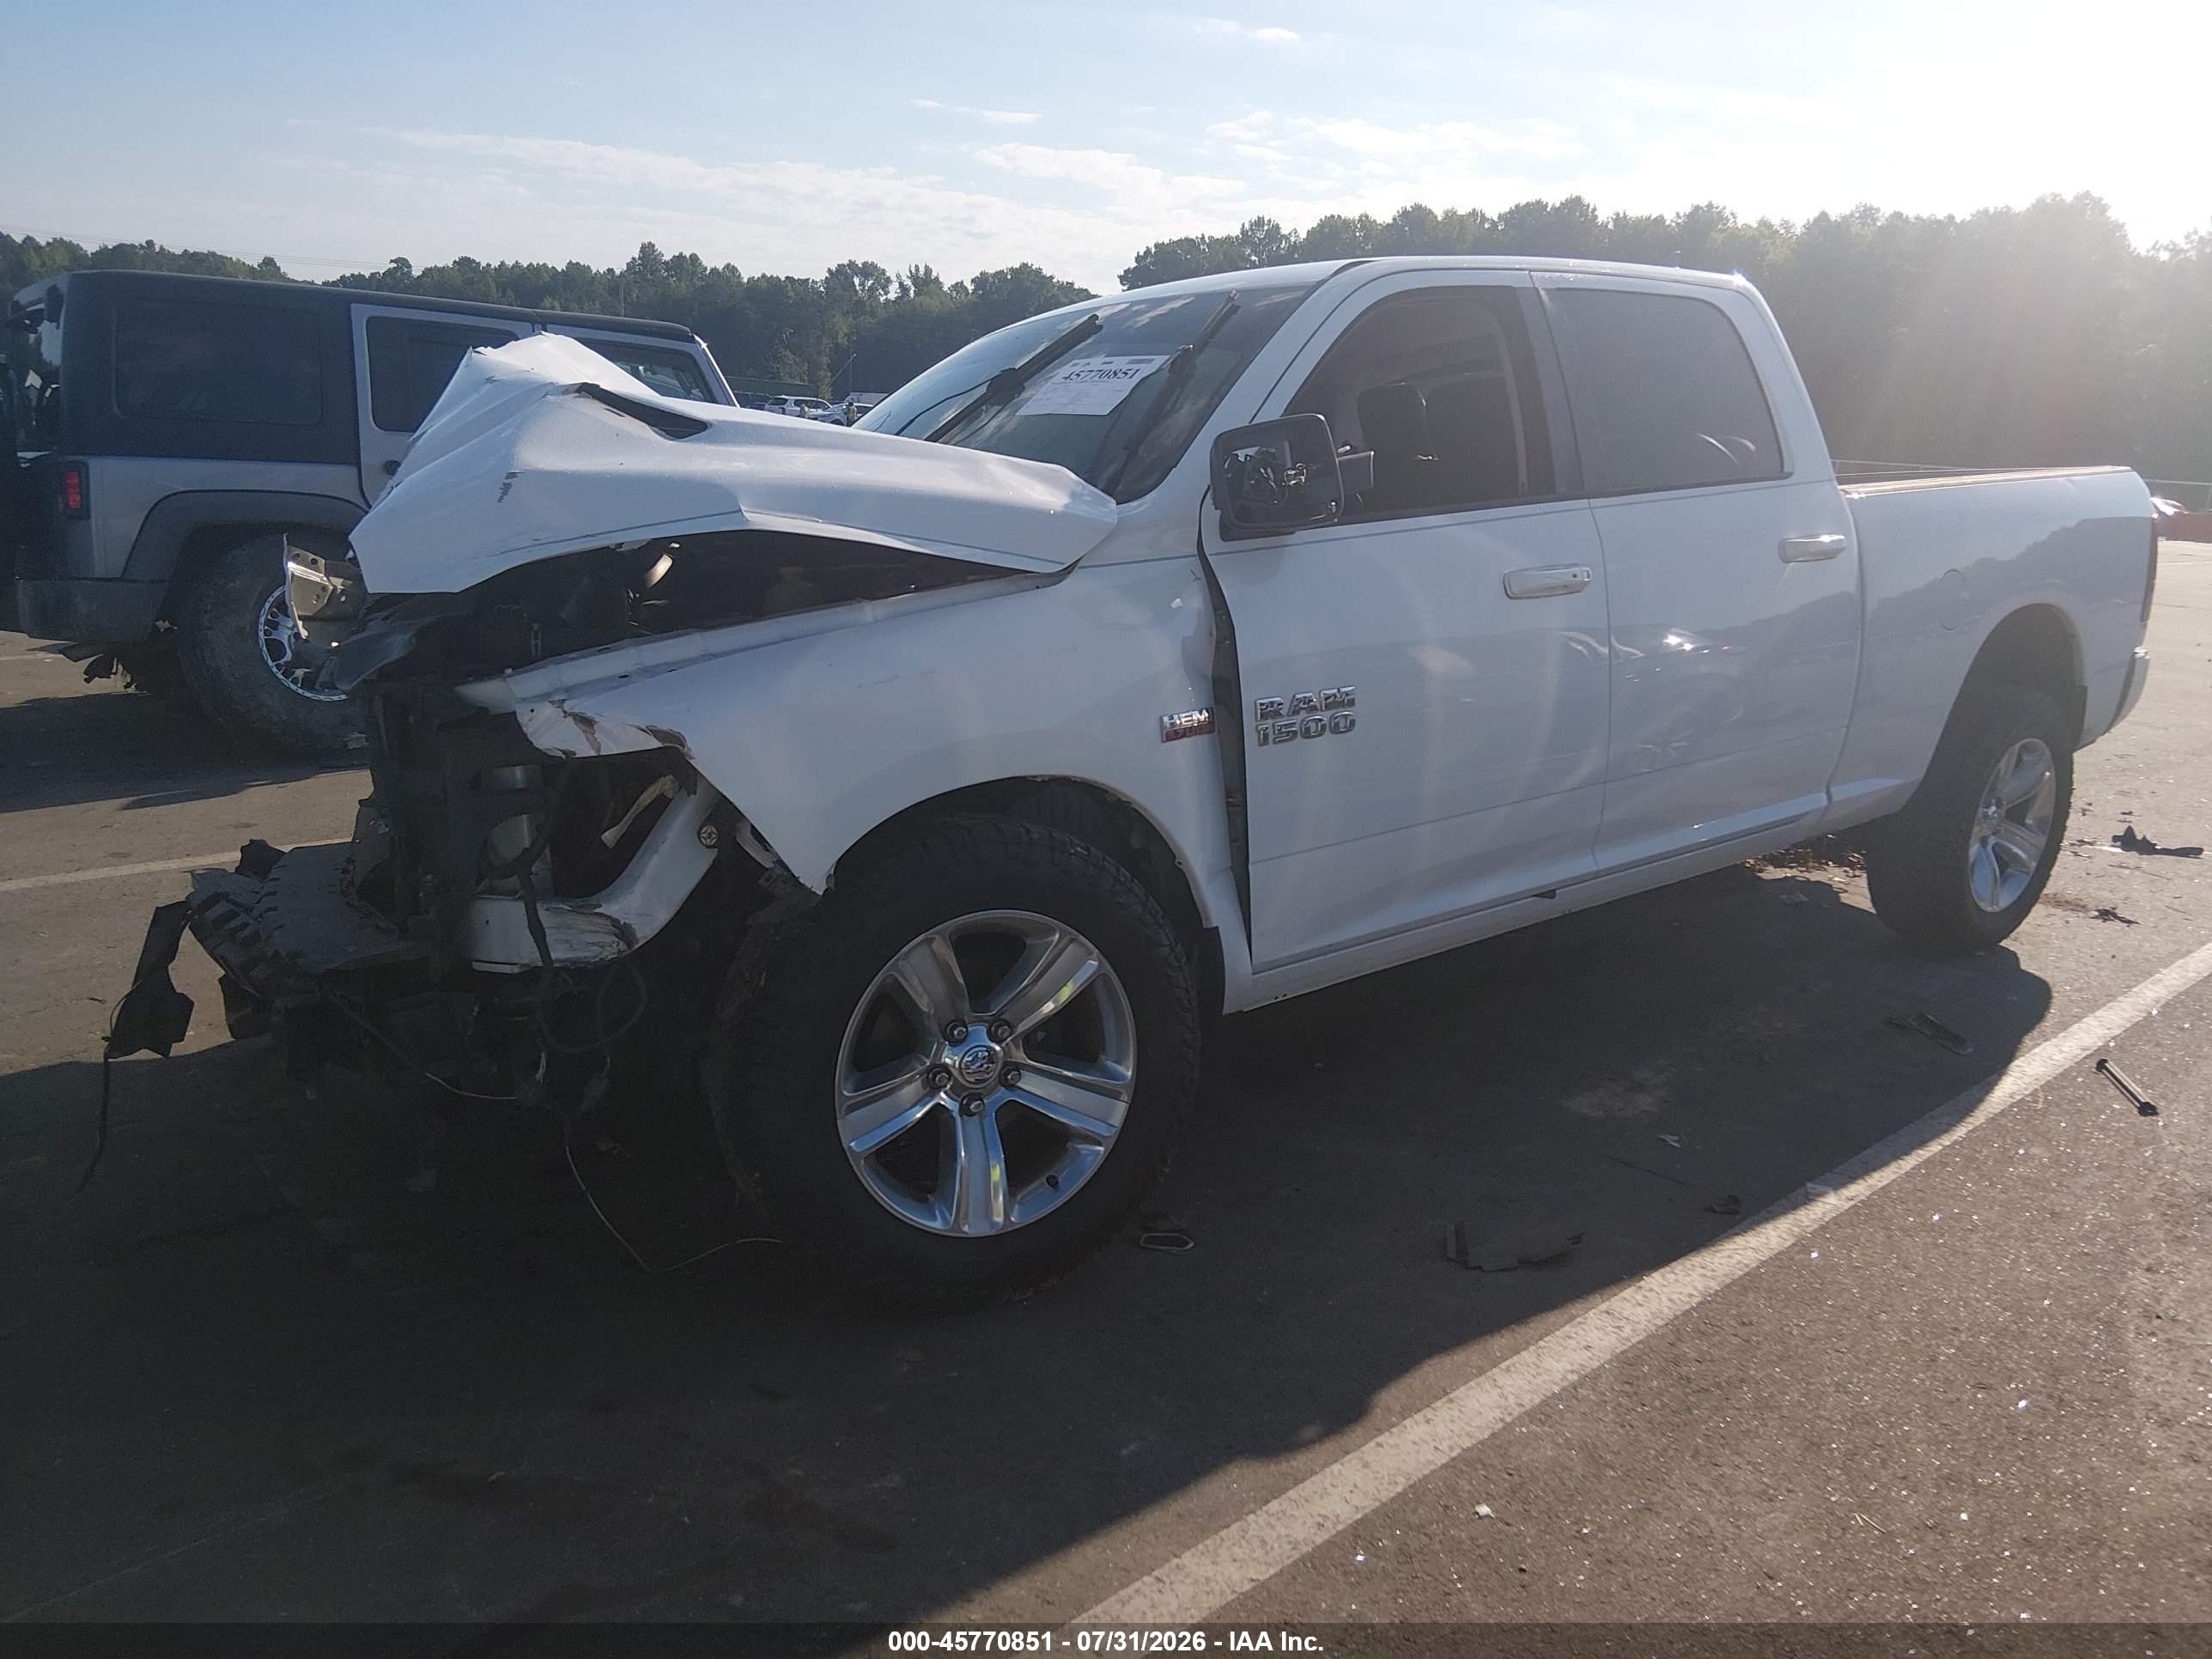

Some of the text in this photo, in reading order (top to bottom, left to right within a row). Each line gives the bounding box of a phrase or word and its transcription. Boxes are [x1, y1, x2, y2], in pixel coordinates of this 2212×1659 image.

[1062, 368, 1141, 381] 45770851
[1255, 685, 1356, 721] RAM
[1255, 711, 1356, 747] 1500
